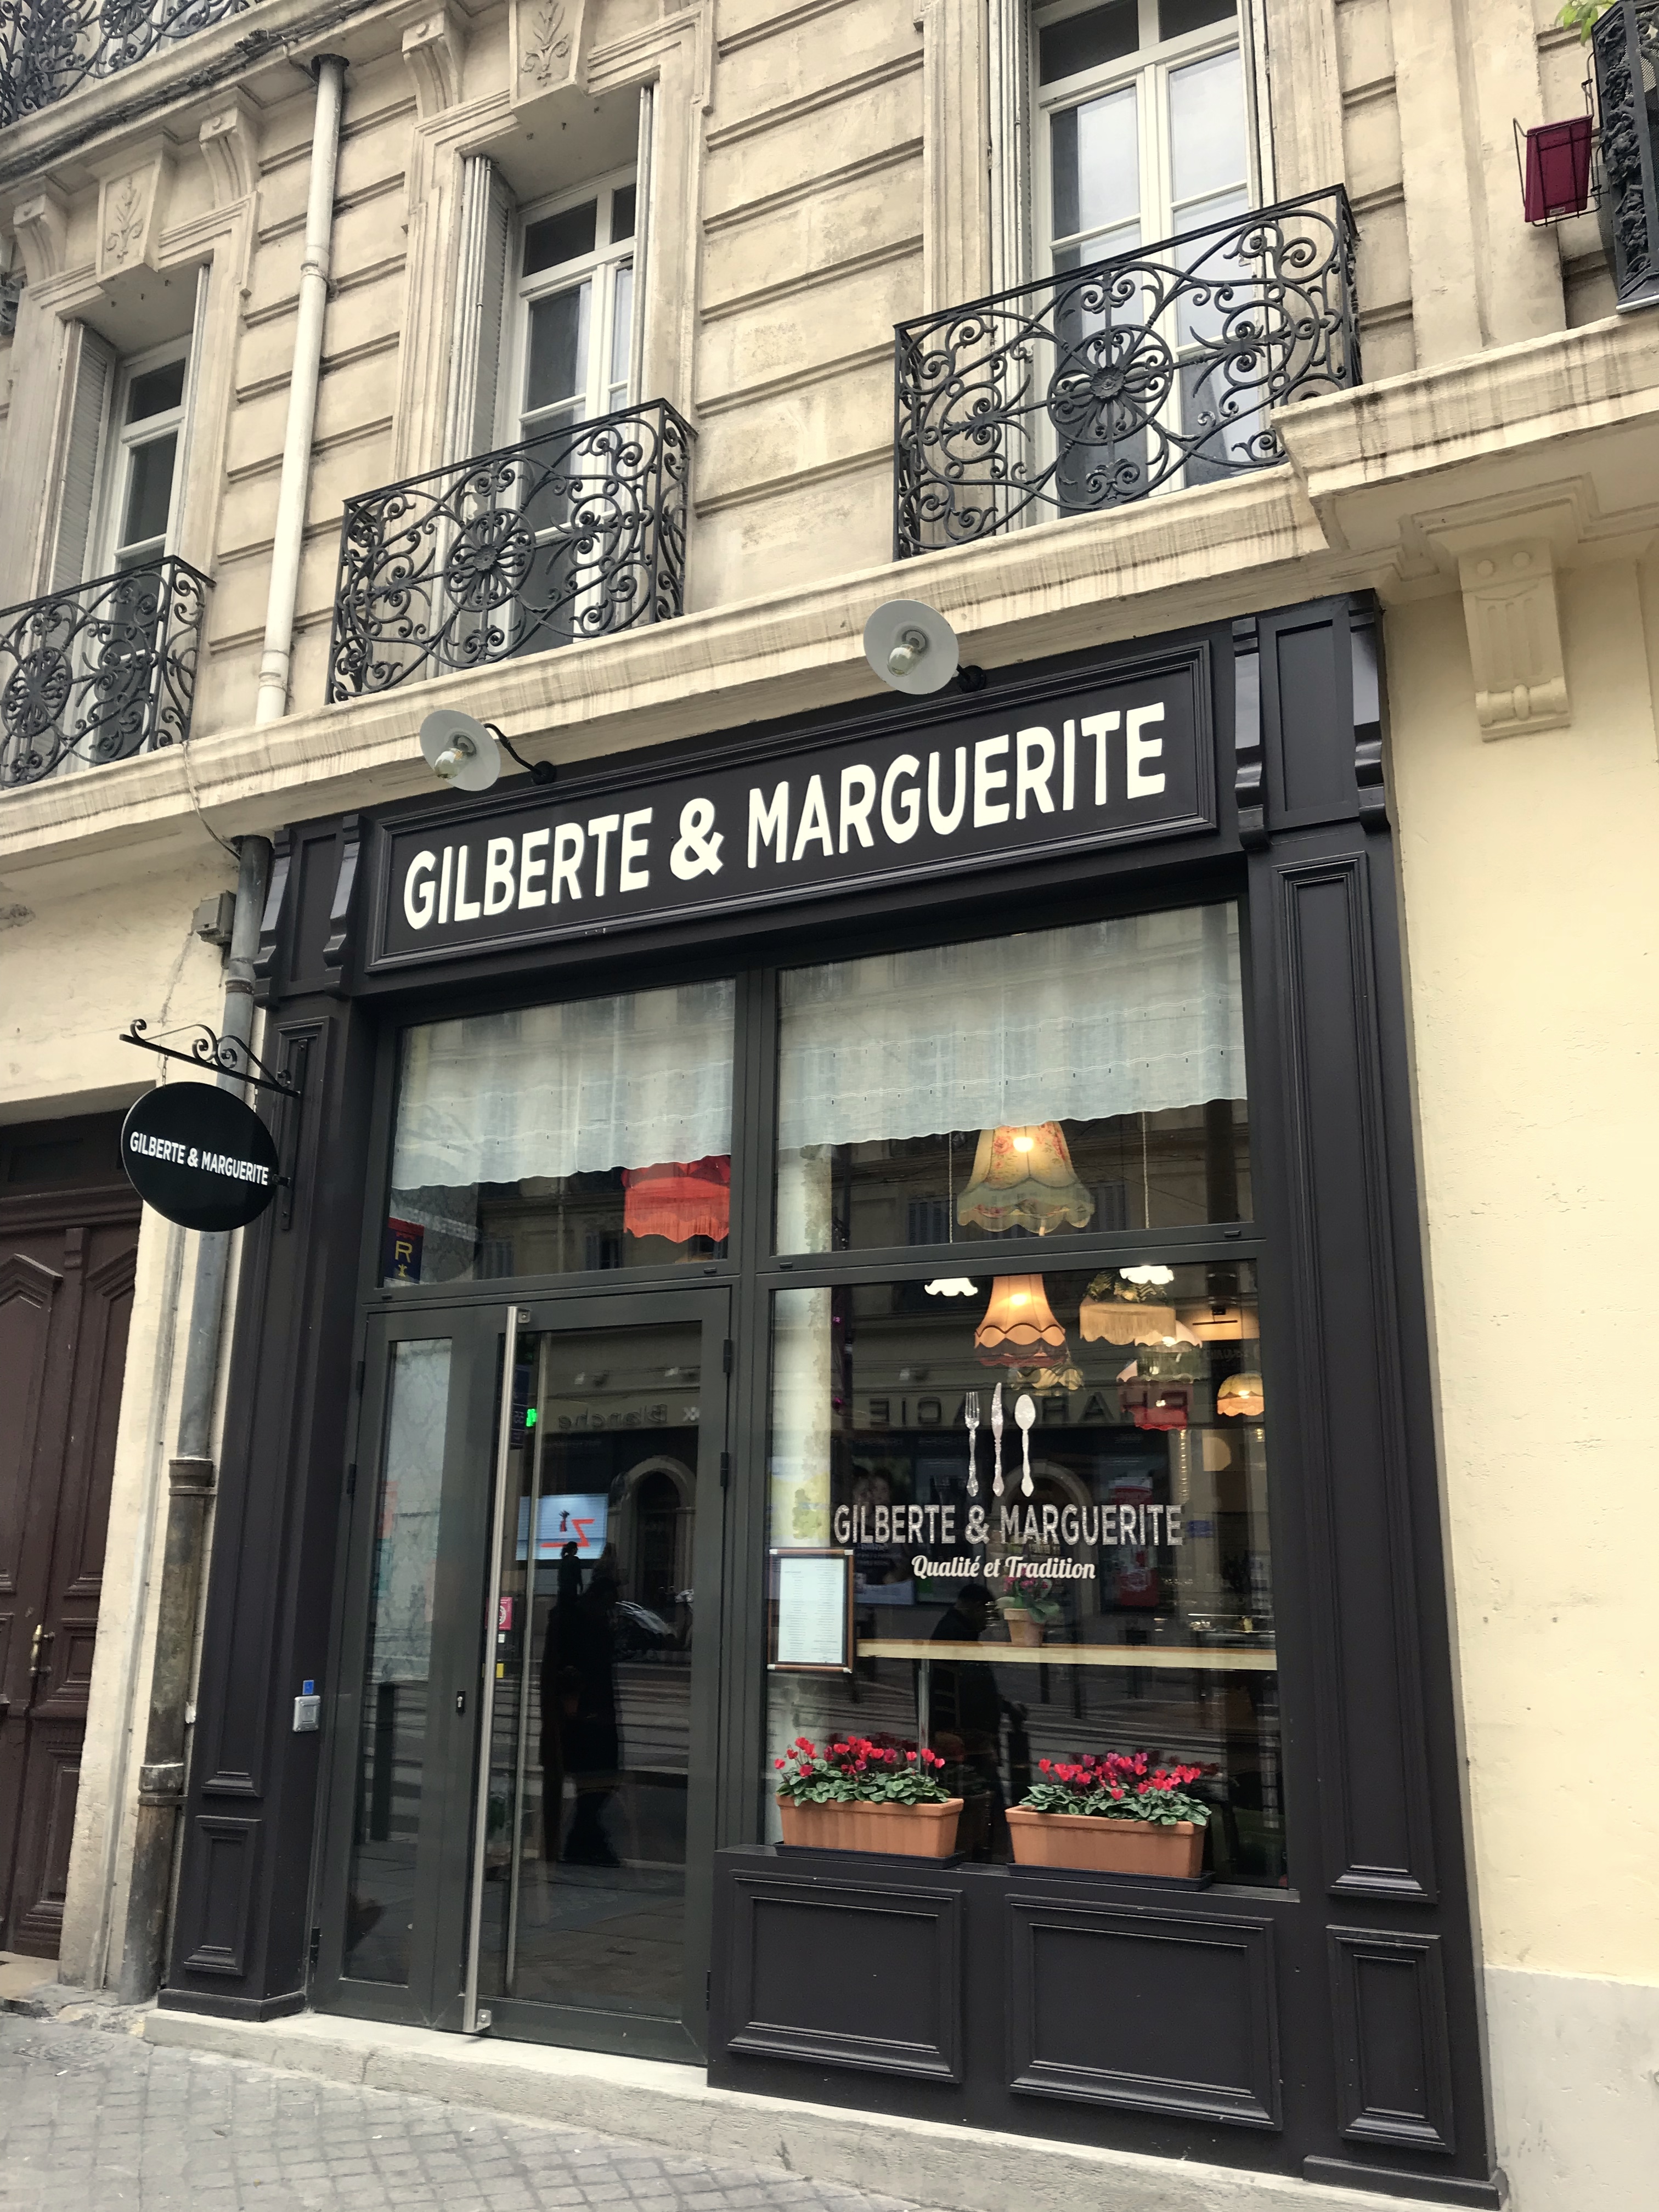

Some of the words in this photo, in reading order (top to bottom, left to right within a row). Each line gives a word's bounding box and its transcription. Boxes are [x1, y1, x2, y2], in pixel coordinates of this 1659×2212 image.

[403, 806, 653, 930] GILBERTE
[669, 797, 725, 881] &
[747, 701, 1166, 869] MARGUERITE
[129, 1131, 186, 1165] GILBERTE
[187, 1148, 199, 1168] &
[201, 1151, 269, 1186] MARGUERITE
[395, 1240, 413, 1263] R
[834, 1504, 956, 1544] GILBERTE
[964, 1504, 990, 1544] &
[1000, 1504, 1183, 1545] MARGUERITE
[911, 1555, 981, 1579] Qualité
[983, 1558, 1002, 1578] et
[1005, 1556, 1096, 1579] Tradition
